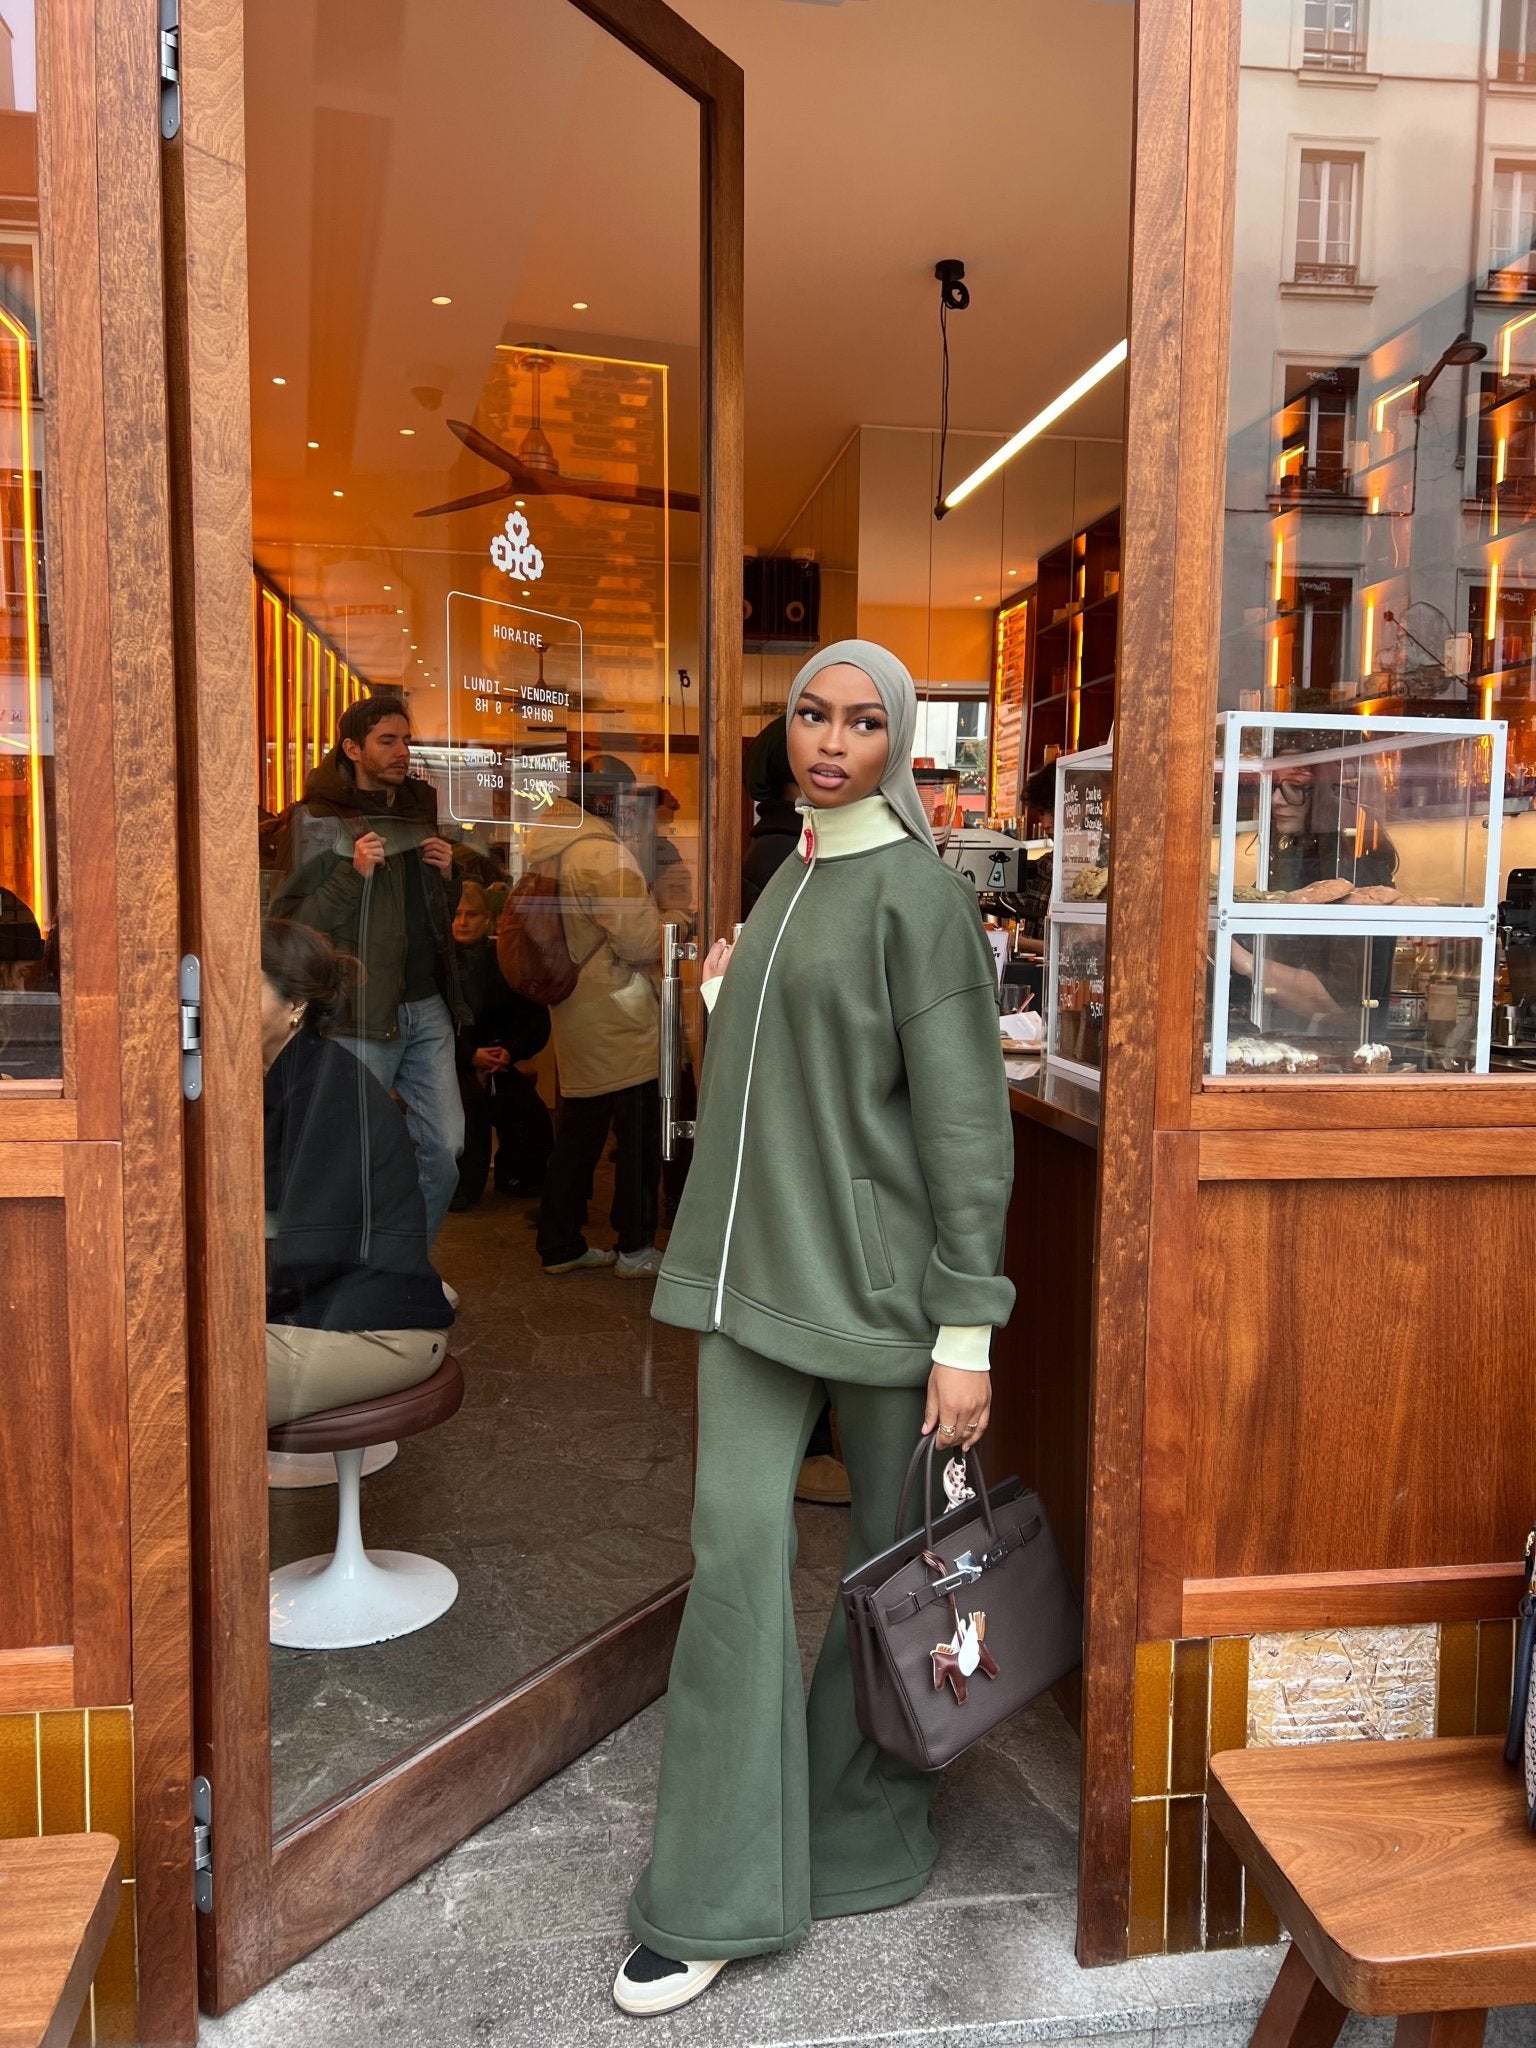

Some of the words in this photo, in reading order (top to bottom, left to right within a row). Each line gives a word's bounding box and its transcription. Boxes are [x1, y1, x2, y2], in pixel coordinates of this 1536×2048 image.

[493, 624, 543, 648] HORAIRE
[463, 675, 500, 695] LUNDI
[520, 685, 570, 707] VENDREDI
[522, 755, 571, 774] DIMANCHE
[476, 773, 504, 789] 9H30
